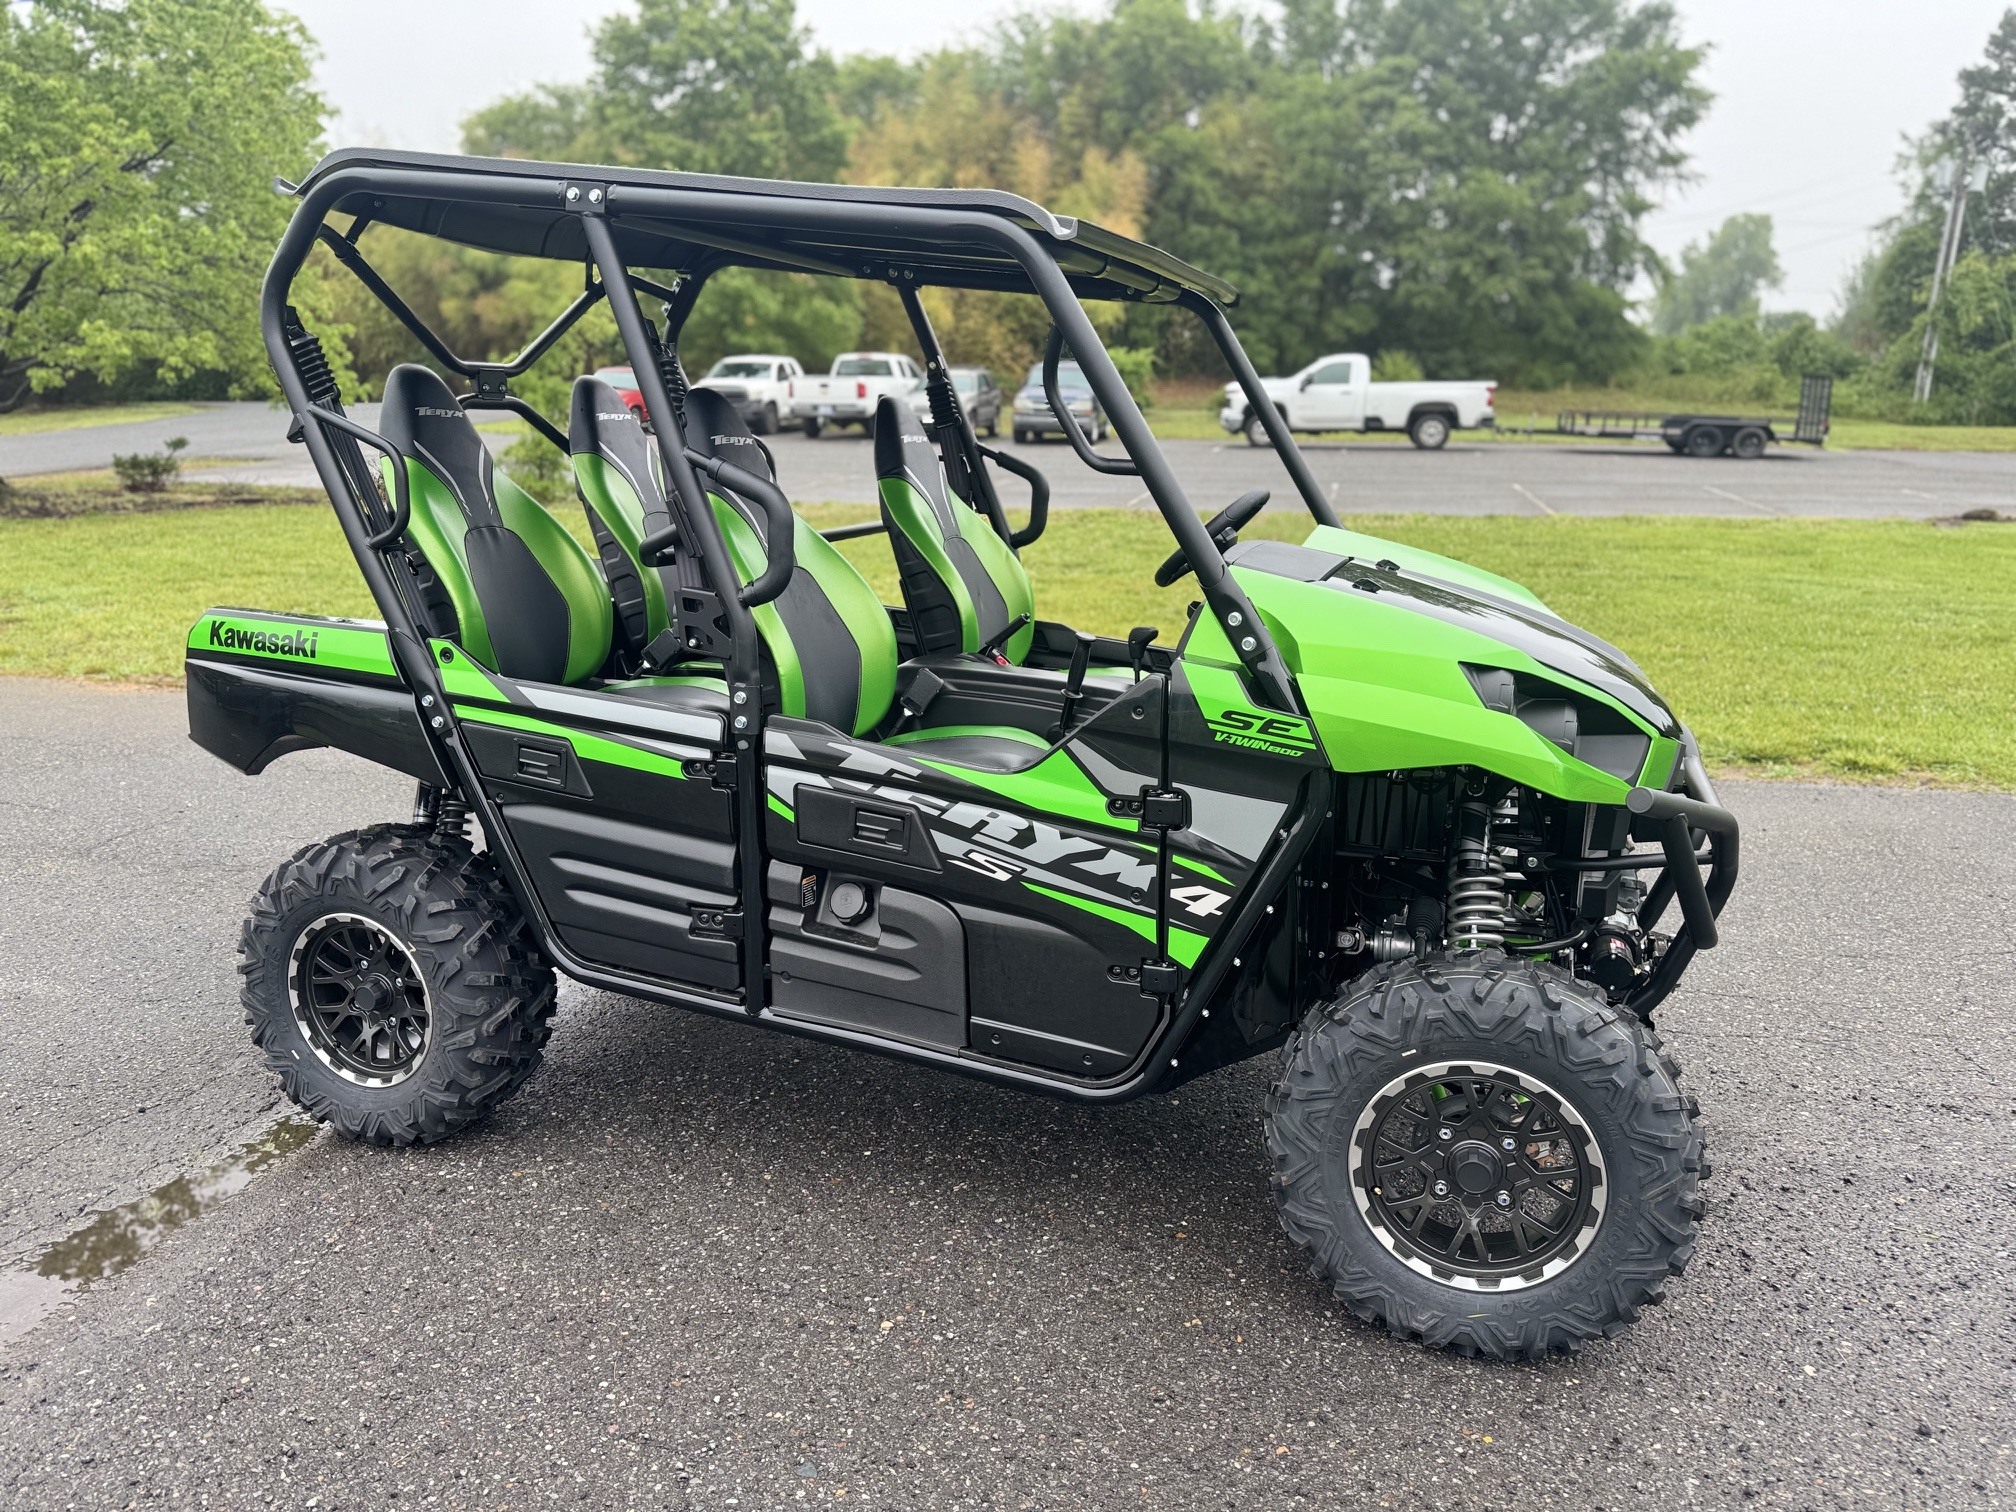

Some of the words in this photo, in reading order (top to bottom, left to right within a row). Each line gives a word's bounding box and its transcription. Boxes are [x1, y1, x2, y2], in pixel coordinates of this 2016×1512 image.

[415, 406, 464, 418] TERYX
[596, 412, 632, 421] TERYX
[710, 434, 754, 446] TERYX
[209, 620, 318, 658] Kawasaki
[1220, 709, 1304, 740] SE
